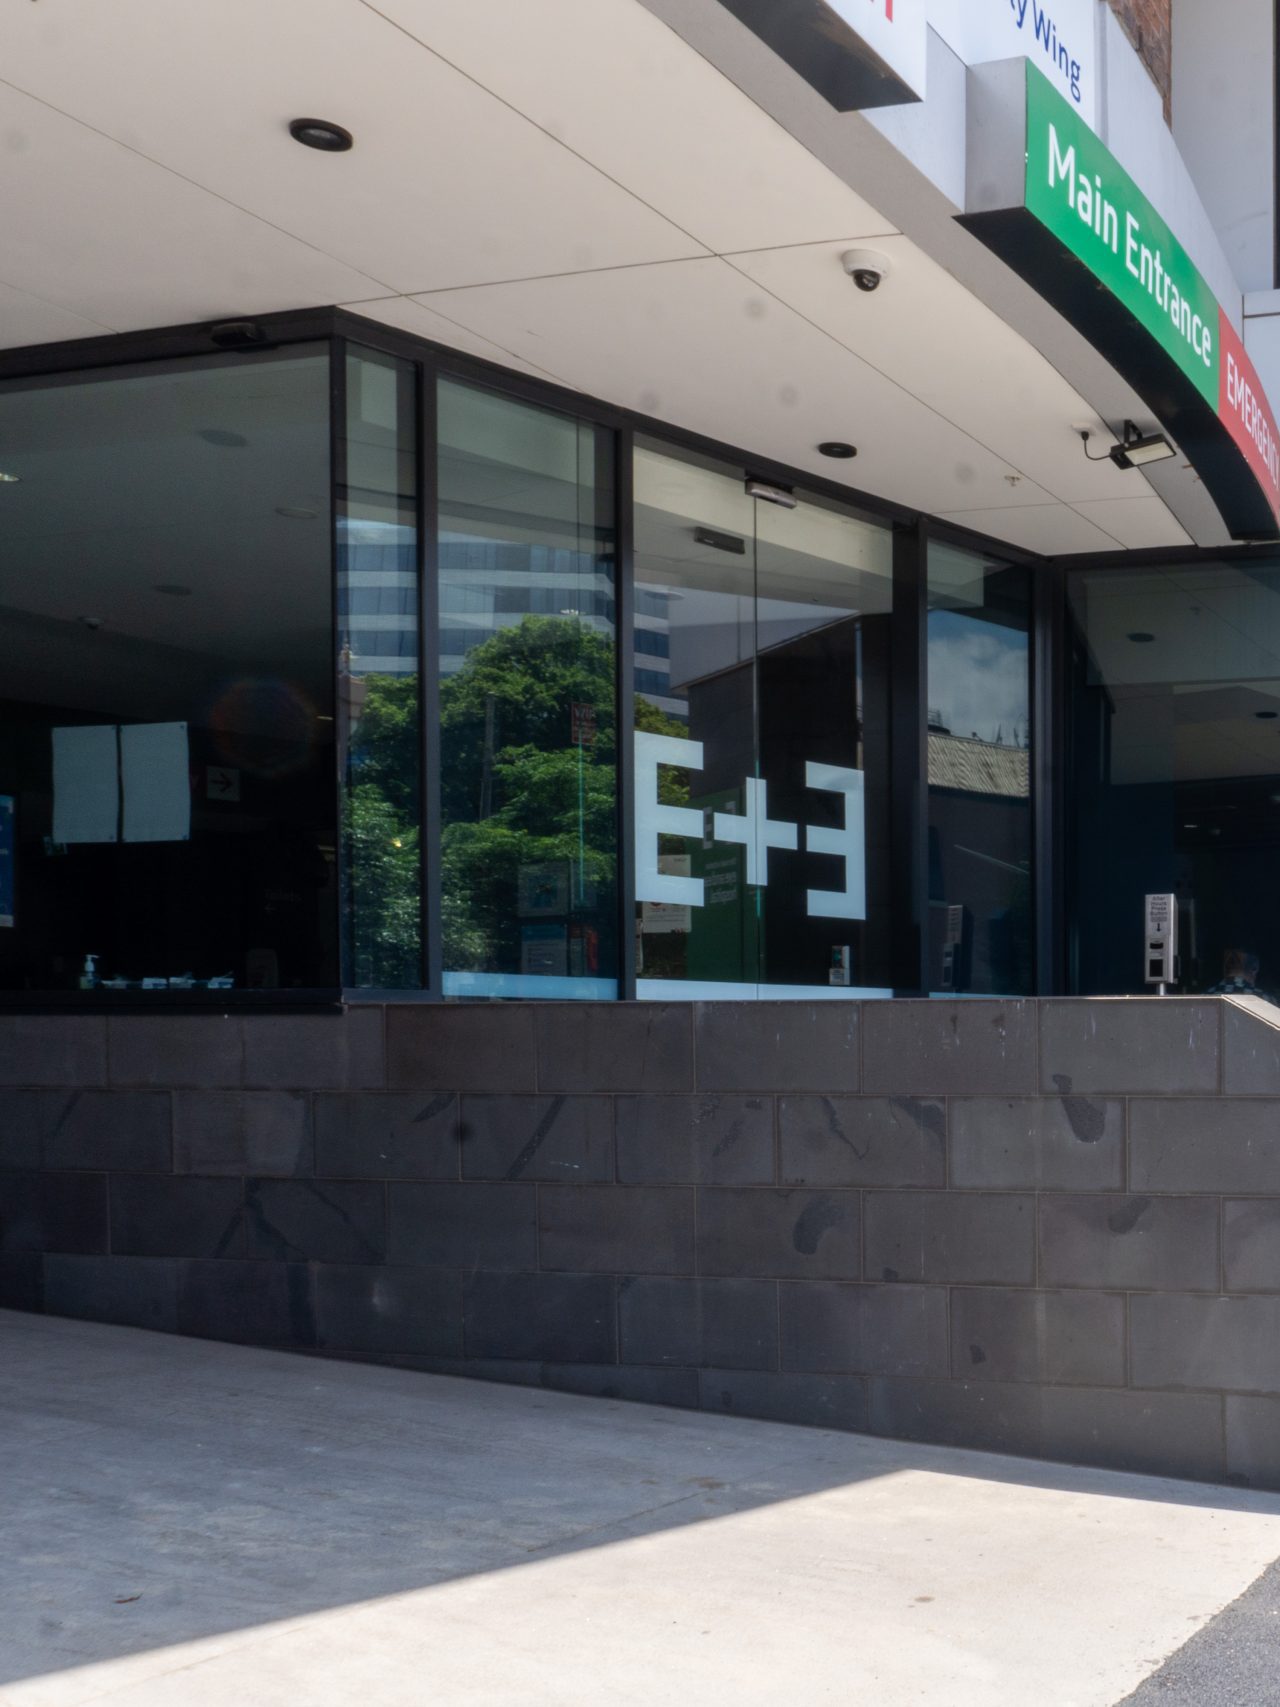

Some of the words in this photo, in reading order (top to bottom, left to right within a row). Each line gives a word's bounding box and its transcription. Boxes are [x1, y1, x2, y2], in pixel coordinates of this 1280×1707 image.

[1032, 0, 1081, 103] Wing
[1048, 122, 1118, 254] Main
[1125, 211, 1212, 368] Entrance
[1226, 352, 1280, 492] EMERGENCY
